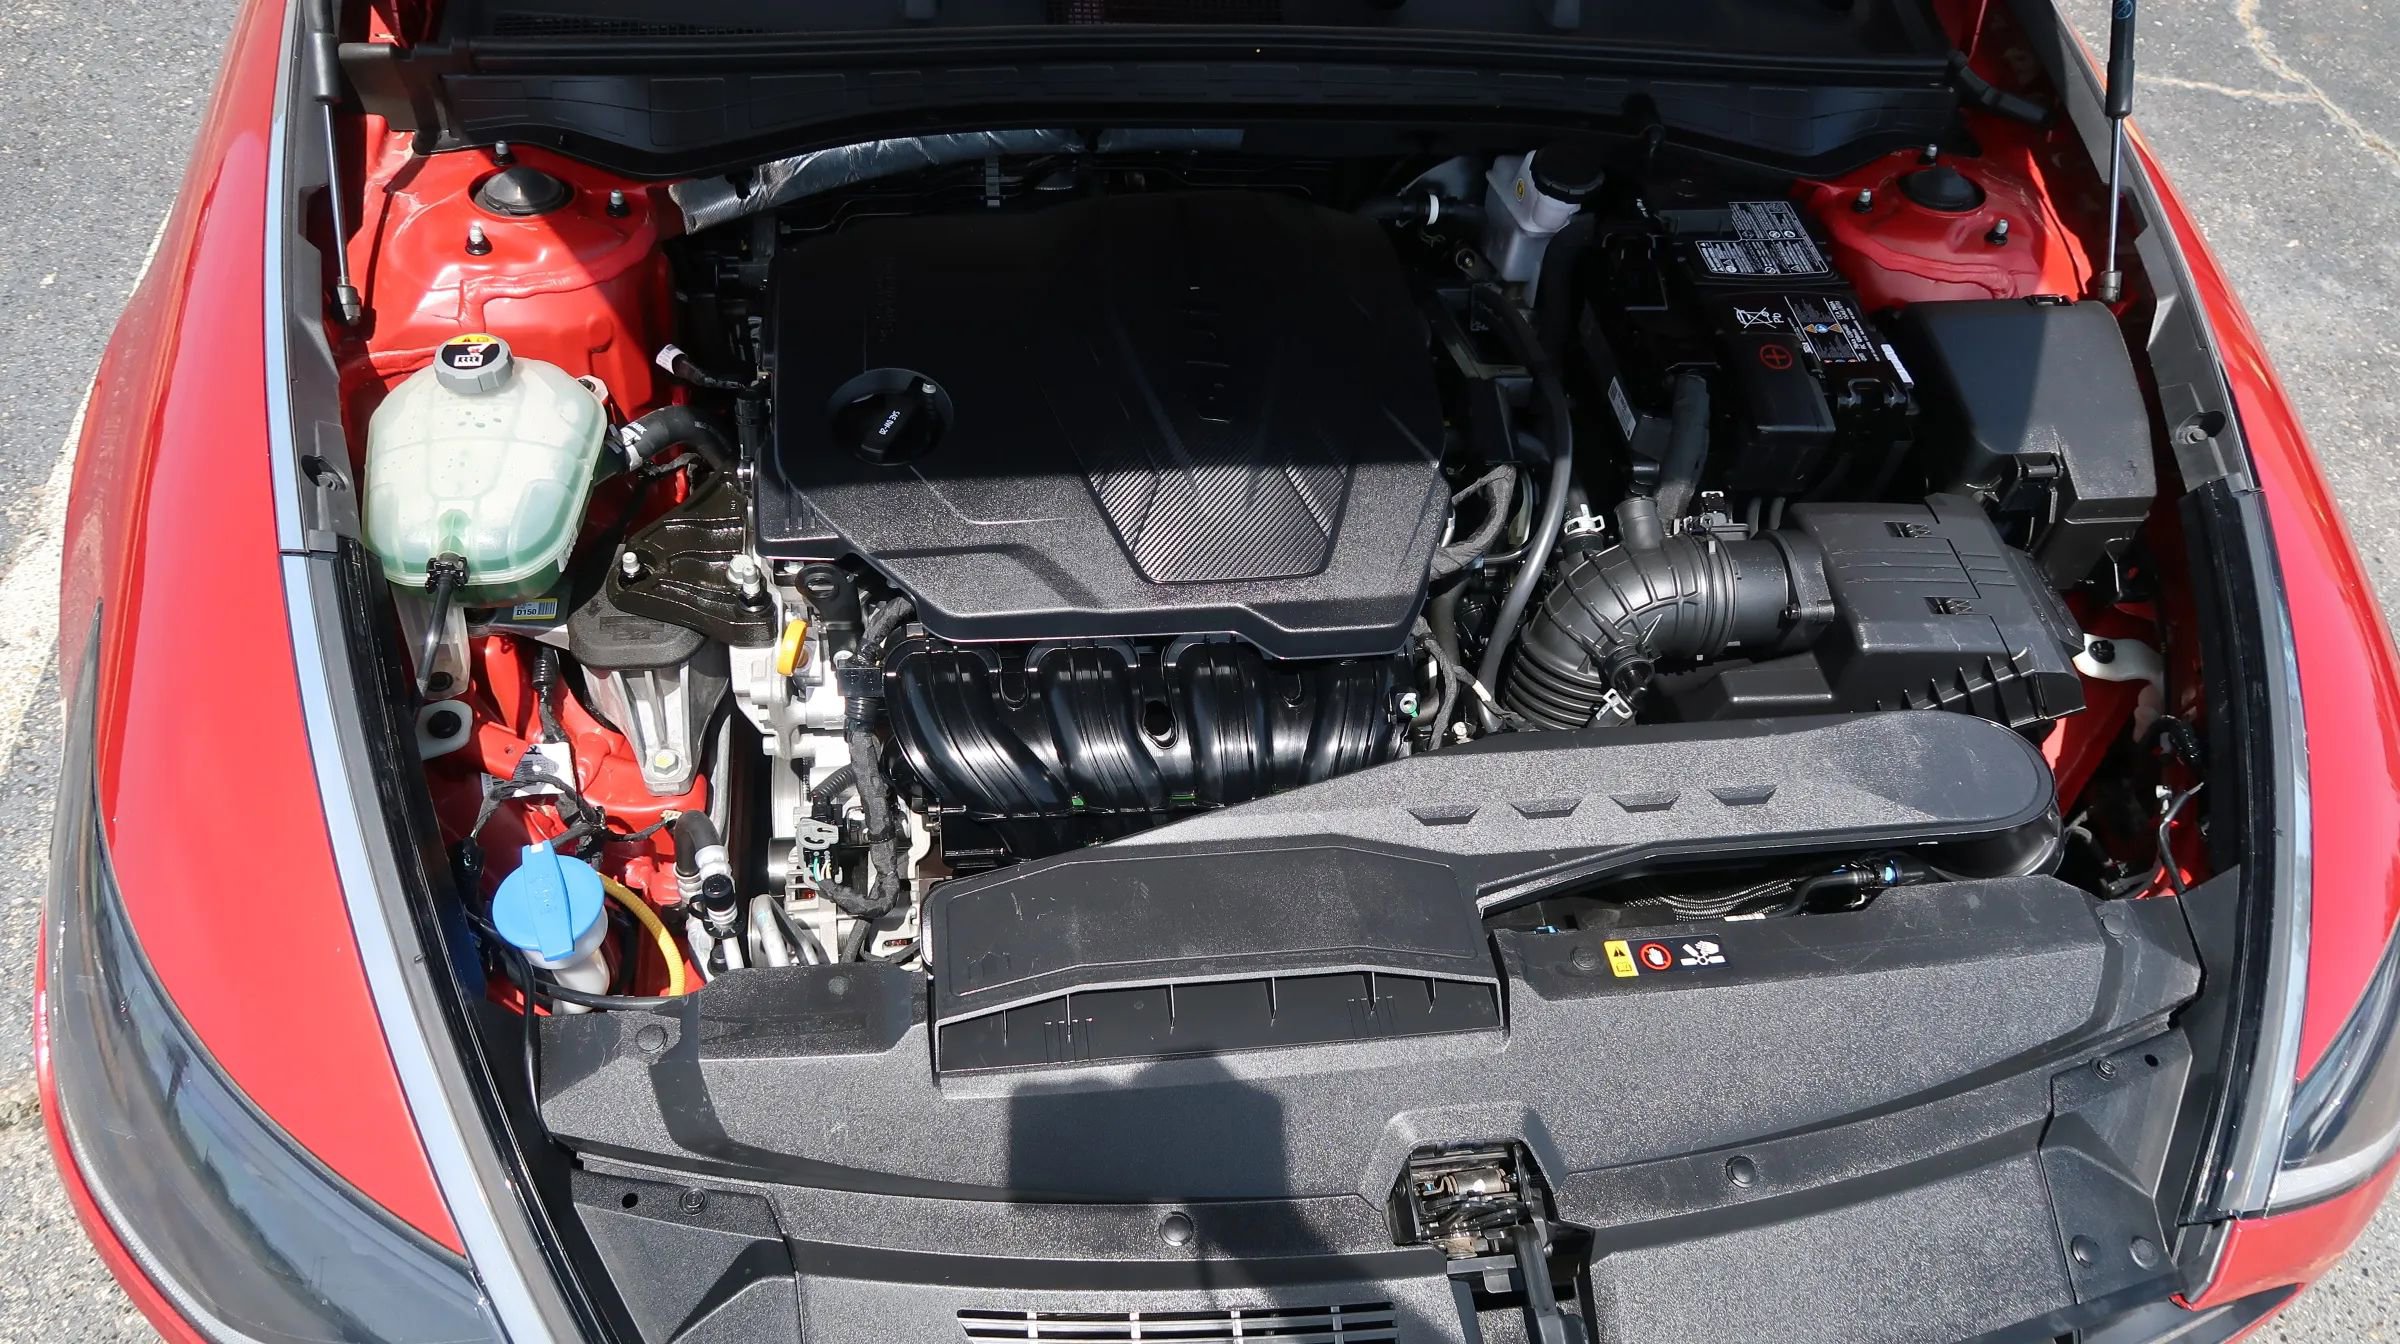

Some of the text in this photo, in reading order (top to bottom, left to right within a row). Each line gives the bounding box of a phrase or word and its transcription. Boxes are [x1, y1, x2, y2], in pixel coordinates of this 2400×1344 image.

[1772, 312, 1785, 323] Pb
[889, 410, 901, 421] SAE
[516, 608, 537, 616] D150
